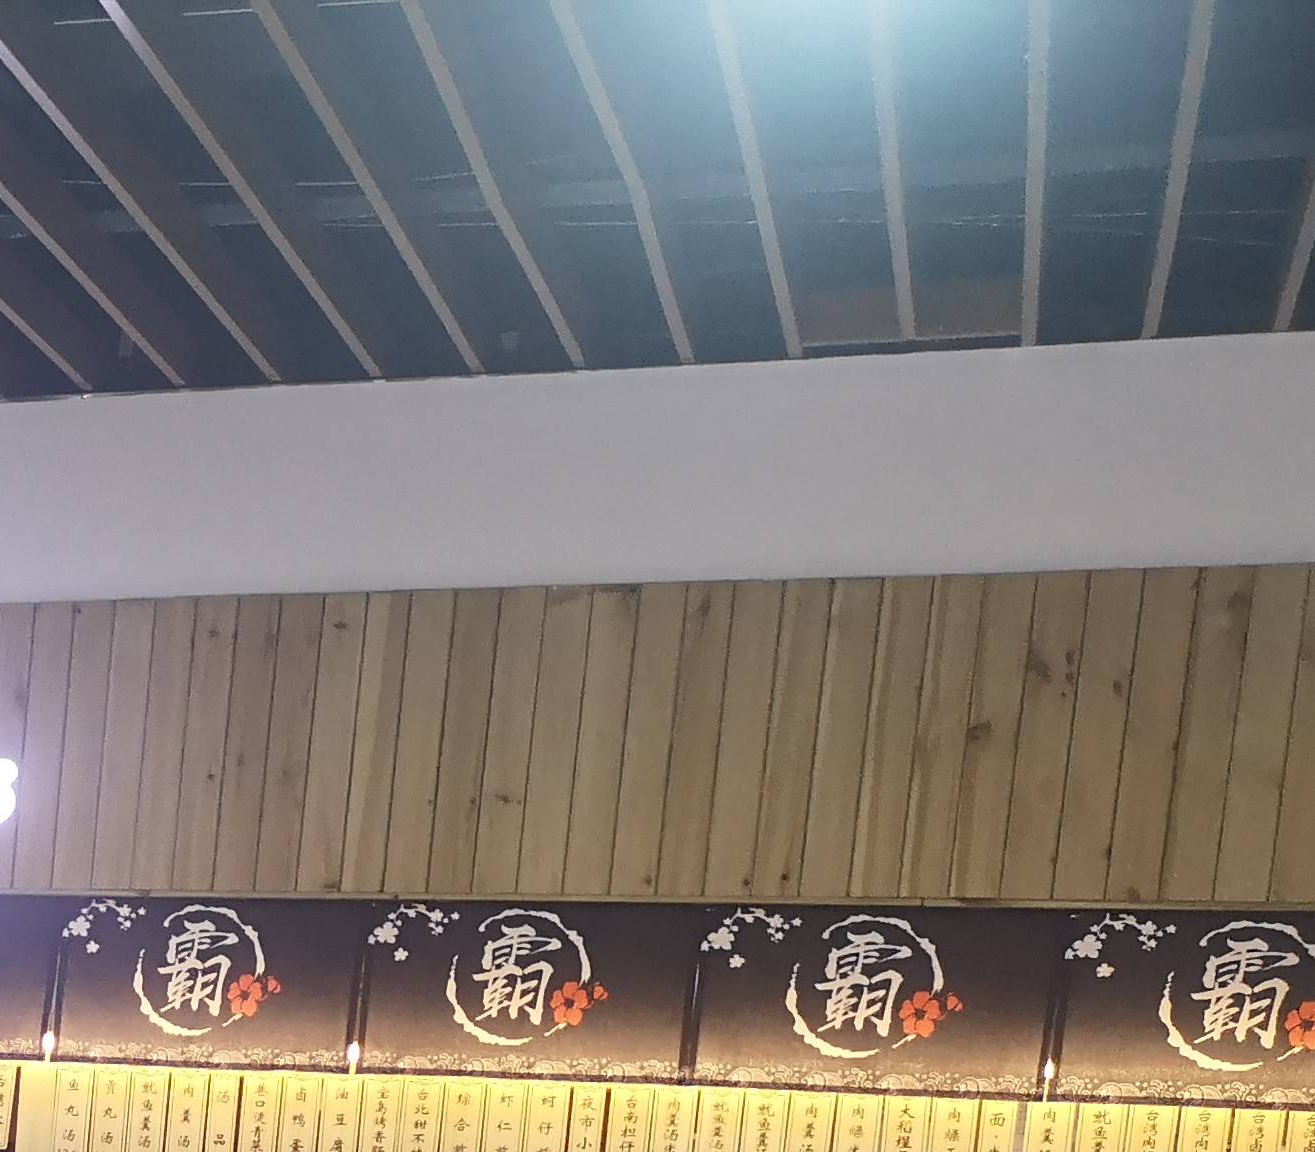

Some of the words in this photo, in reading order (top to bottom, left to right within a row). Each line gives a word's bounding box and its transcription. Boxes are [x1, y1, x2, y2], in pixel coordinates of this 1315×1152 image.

[157, 919, 237, 1017] 霸
[475, 925, 560, 1026] 霸
[818, 932, 911, 1037] 霸
[1191, 939, 1301, 1049] 霸
[61, 1078, 79, 1142] 鱼丸汤
[177, 1083, 195, 1148] 肉羹汤
[213, 1090, 231, 1146] 汤品
